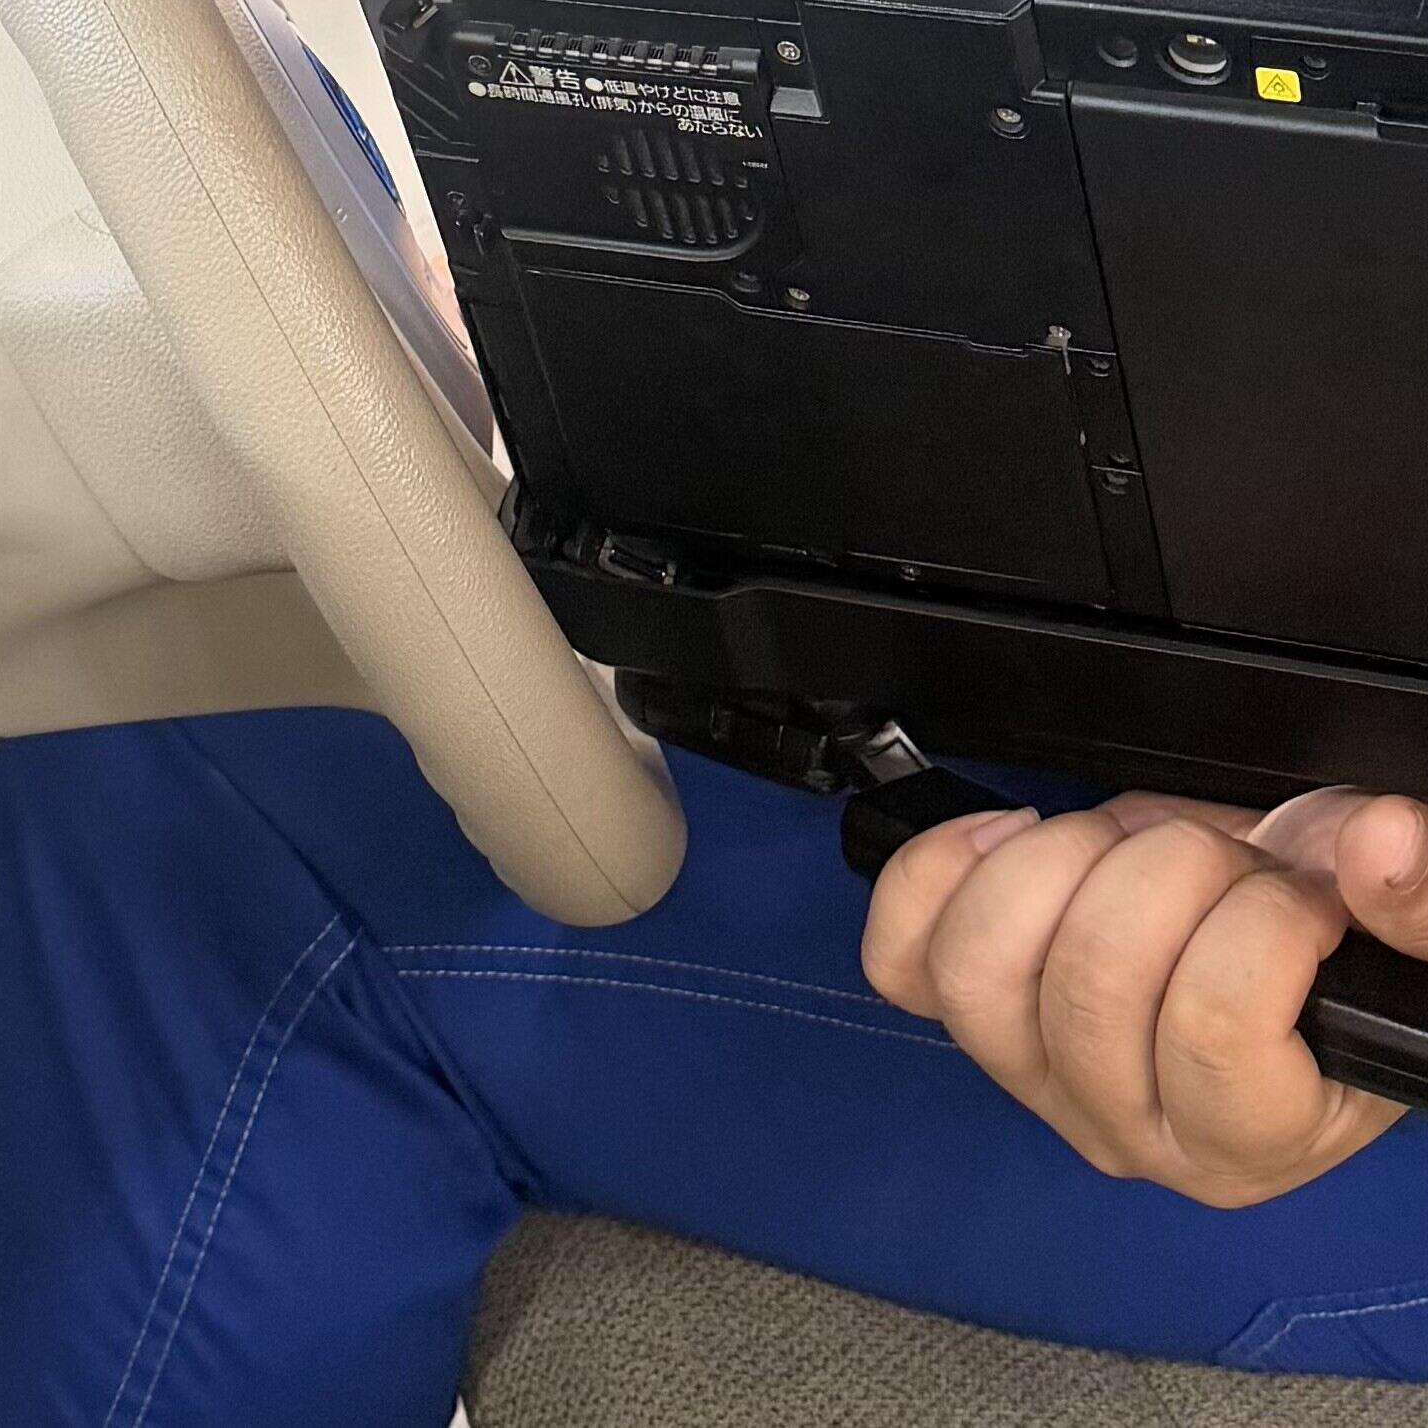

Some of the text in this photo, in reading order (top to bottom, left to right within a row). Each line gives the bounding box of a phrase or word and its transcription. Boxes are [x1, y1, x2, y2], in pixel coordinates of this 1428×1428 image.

[528, 65, 742, 107] 警告 低温やけどに注意
[676, 117, 764, 139] あたらない
